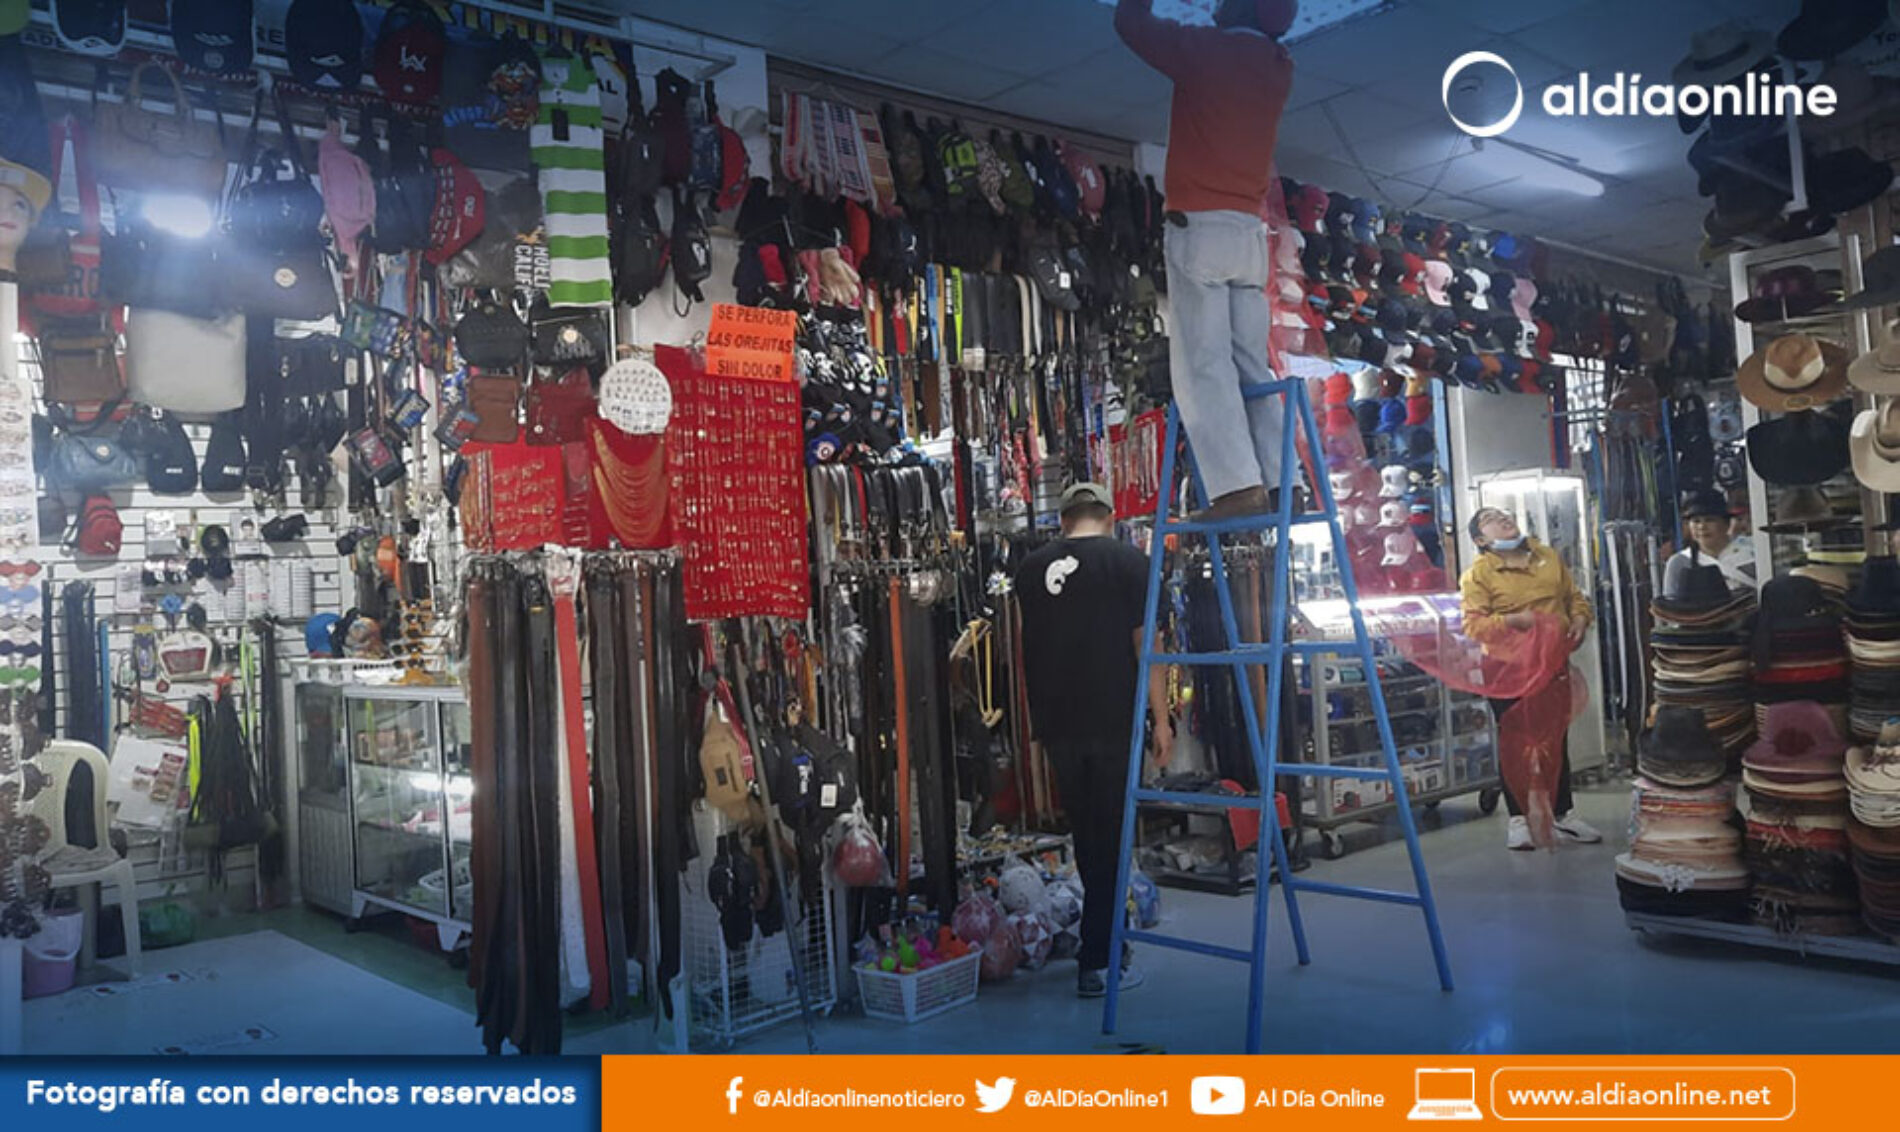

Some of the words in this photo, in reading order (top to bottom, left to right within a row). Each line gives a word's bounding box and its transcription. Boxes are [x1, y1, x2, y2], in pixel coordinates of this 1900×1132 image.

[718, 304, 734, 321] SE
[737, 307, 791, 327] PERFORA
[706, 331, 732, 347] LAS
[735, 334, 793, 353] OREJITAS
[717, 359, 739, 375] SIN
[743, 361, 782, 379] DOLOR
